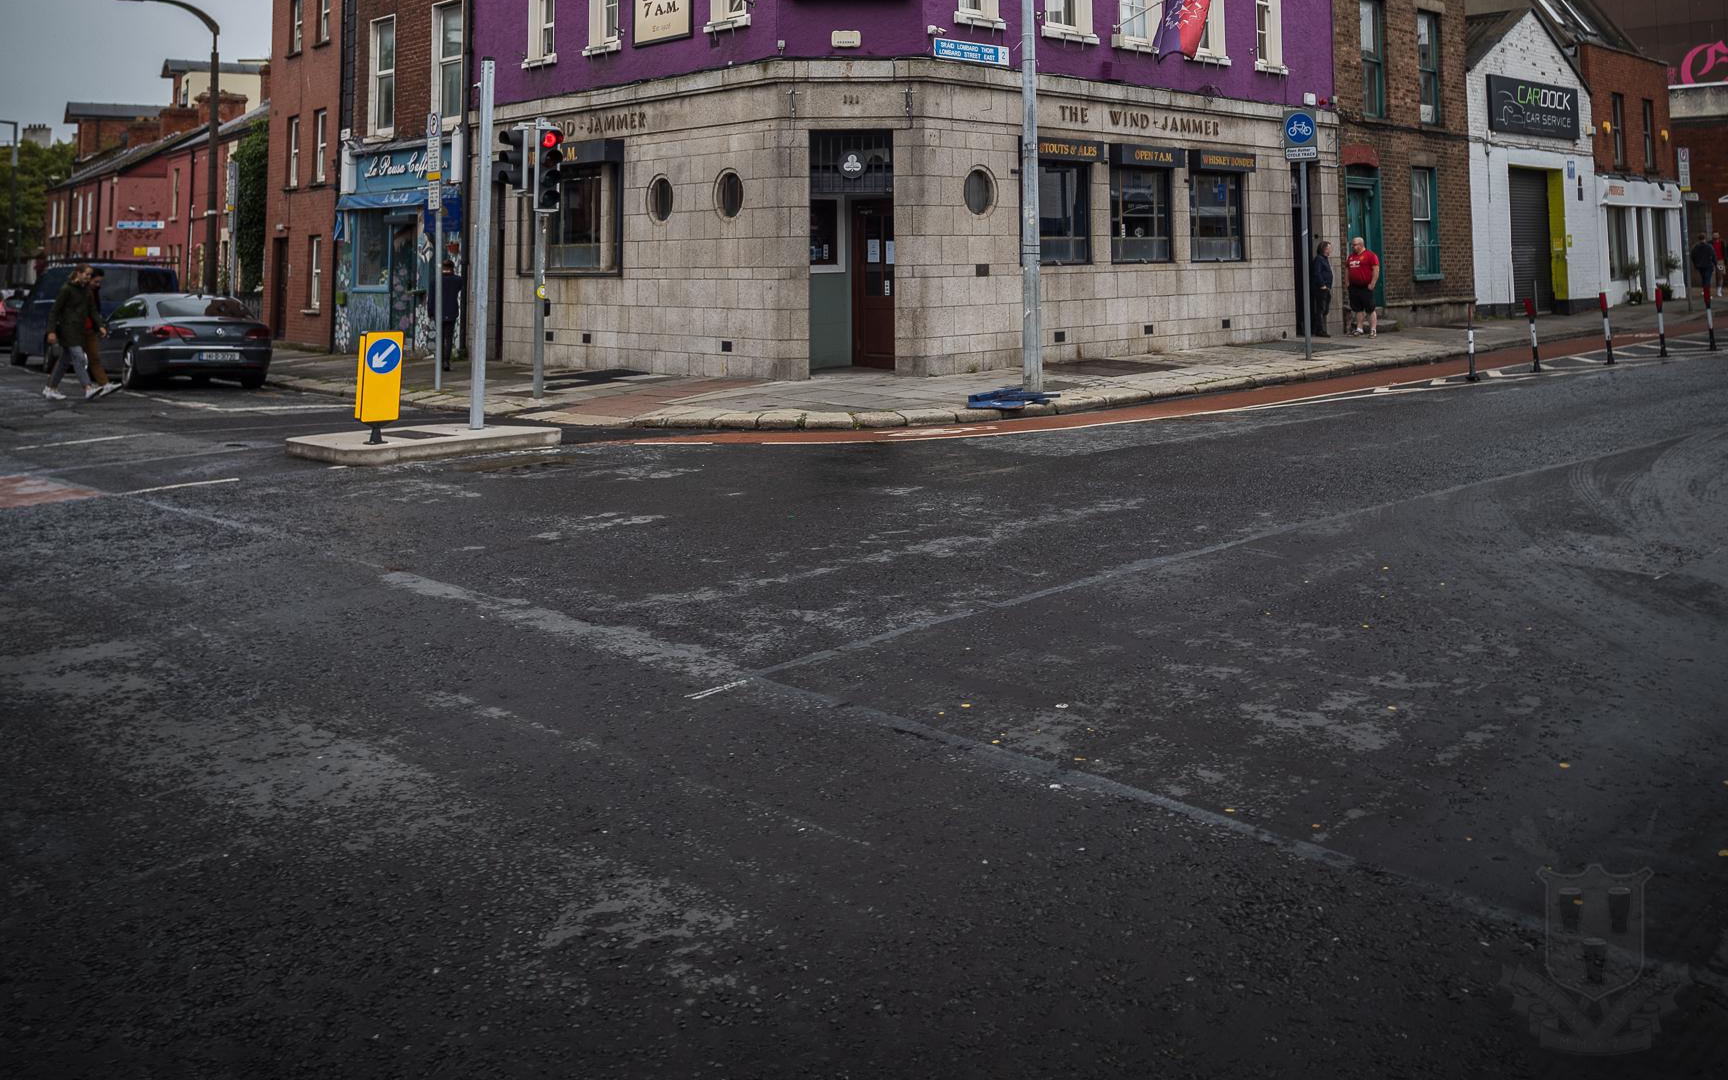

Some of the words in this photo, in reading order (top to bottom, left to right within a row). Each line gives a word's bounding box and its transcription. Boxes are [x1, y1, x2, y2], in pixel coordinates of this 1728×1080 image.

[643, 1, 653, 19] 7
[654, 0, 680, 17] A.M.
[938, 49, 962, 57] LOMBARD
[1001, 51, 1006, 60] 2
[956, 44, 979, 52] LOMBARD
[1517, 85, 1571, 111] CARDOCK
[587, 111, 647, 135] JAMMER
[1059, 104, 1089, 124] THE
[1160, 114, 1220, 137] JAMMER
[1526, 111, 1540, 124] CAR
[1542, 114, 1571, 128] SERVICE
[1039, 142, 1069, 155] STOUTS
[1078, 144, 1098, 157] ALES
[1134, 148, 1153, 161] OPEN
[1154, 150, 1159, 161] 7
[1159, 150, 1174, 163] A.M.
